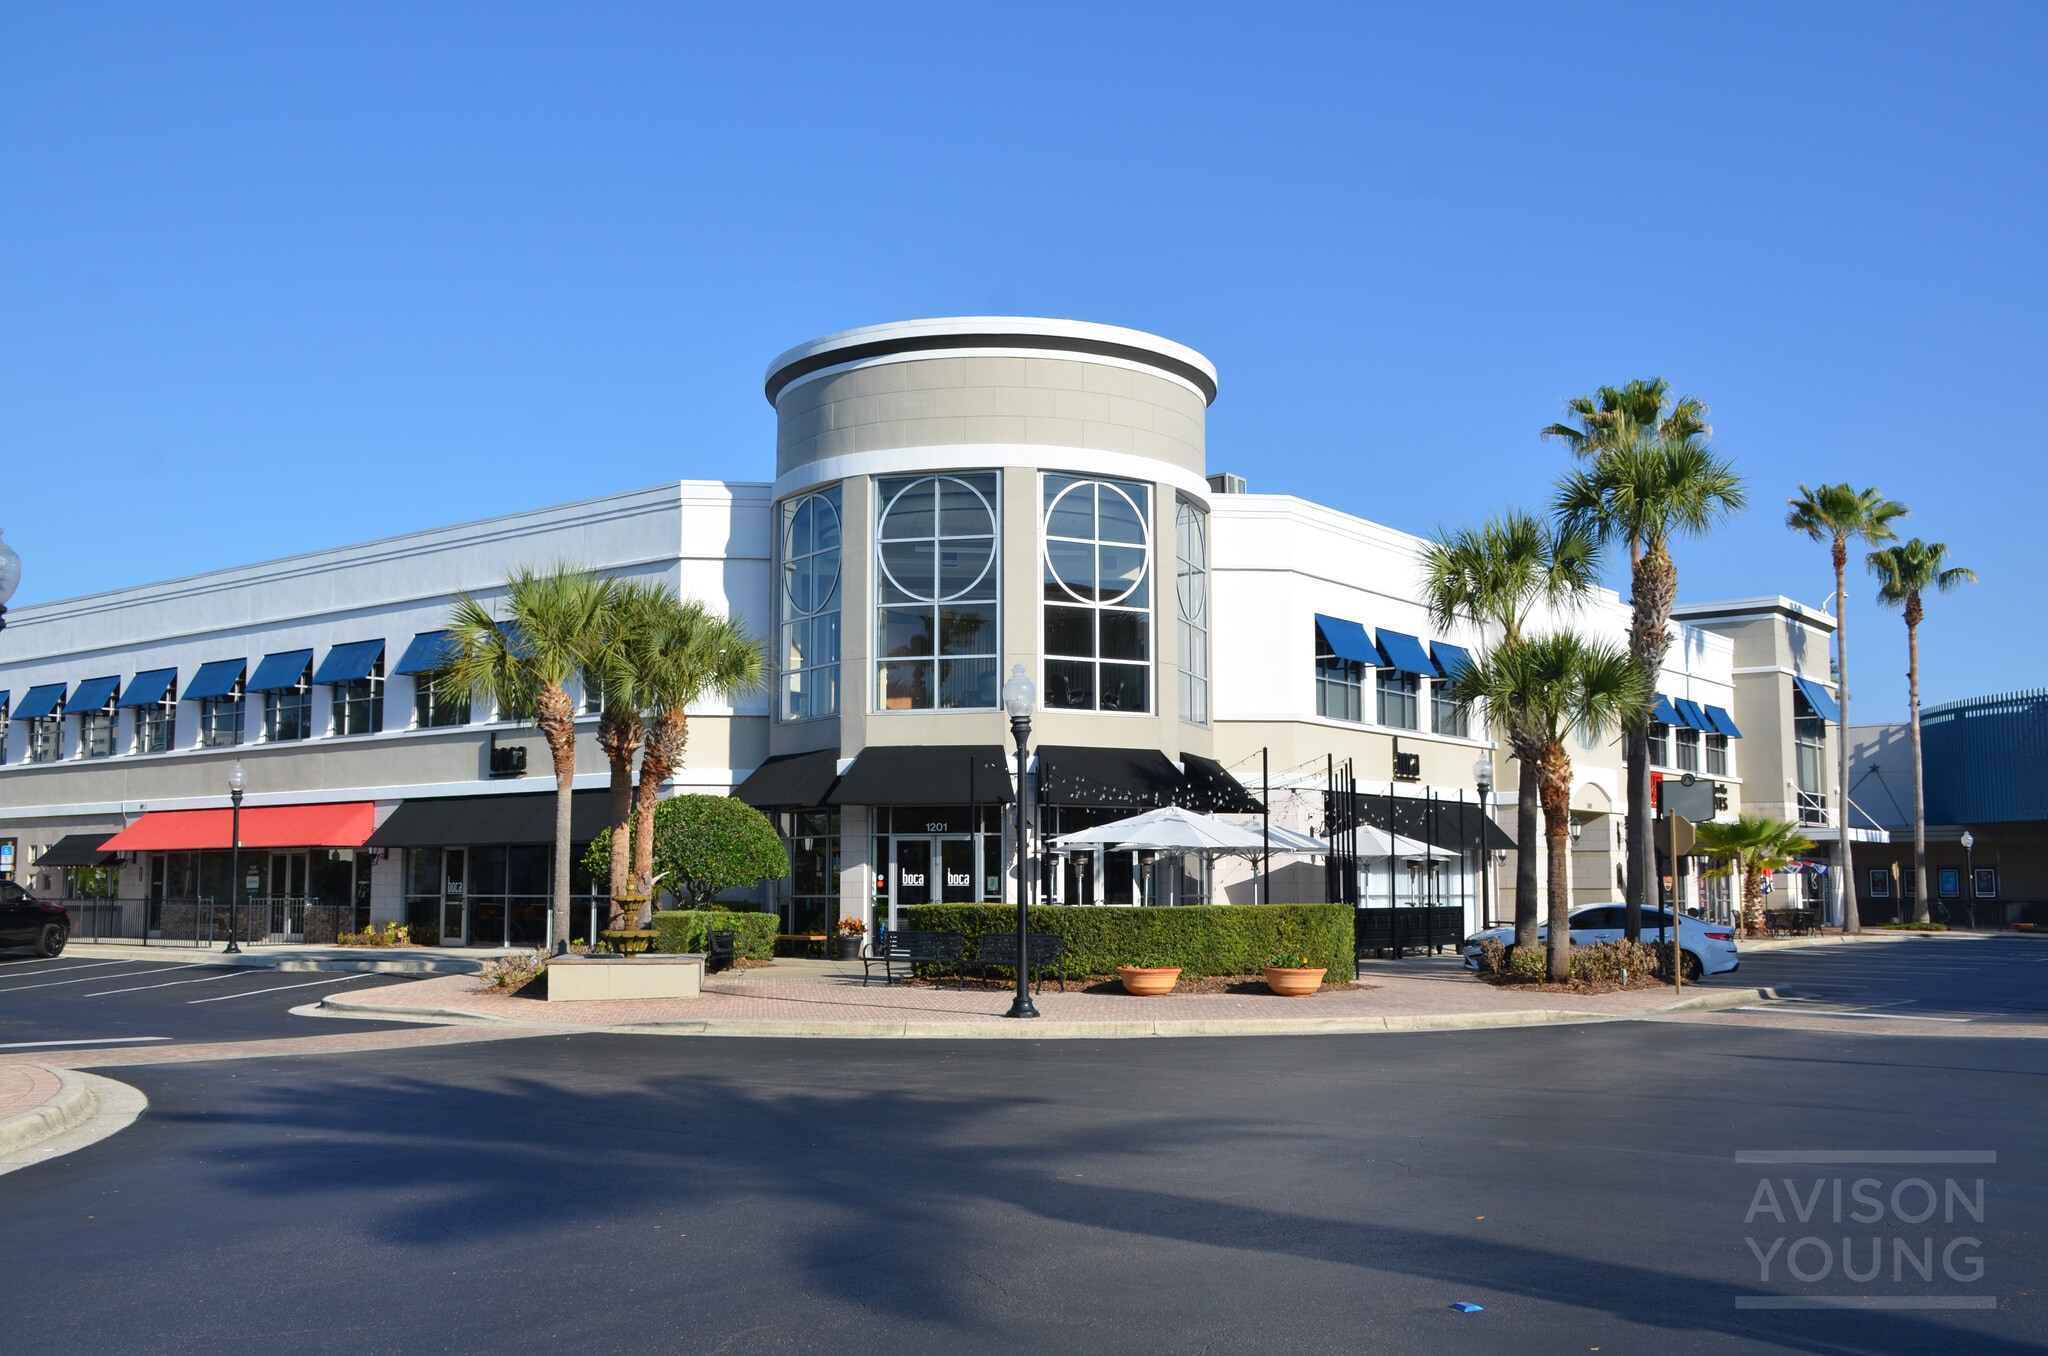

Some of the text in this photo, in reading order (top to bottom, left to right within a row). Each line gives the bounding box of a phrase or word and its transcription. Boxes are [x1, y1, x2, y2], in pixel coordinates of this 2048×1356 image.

[925, 822, 949, 832] 1201
[902, 867, 925, 886] boca
[947, 867, 970, 886] boca
